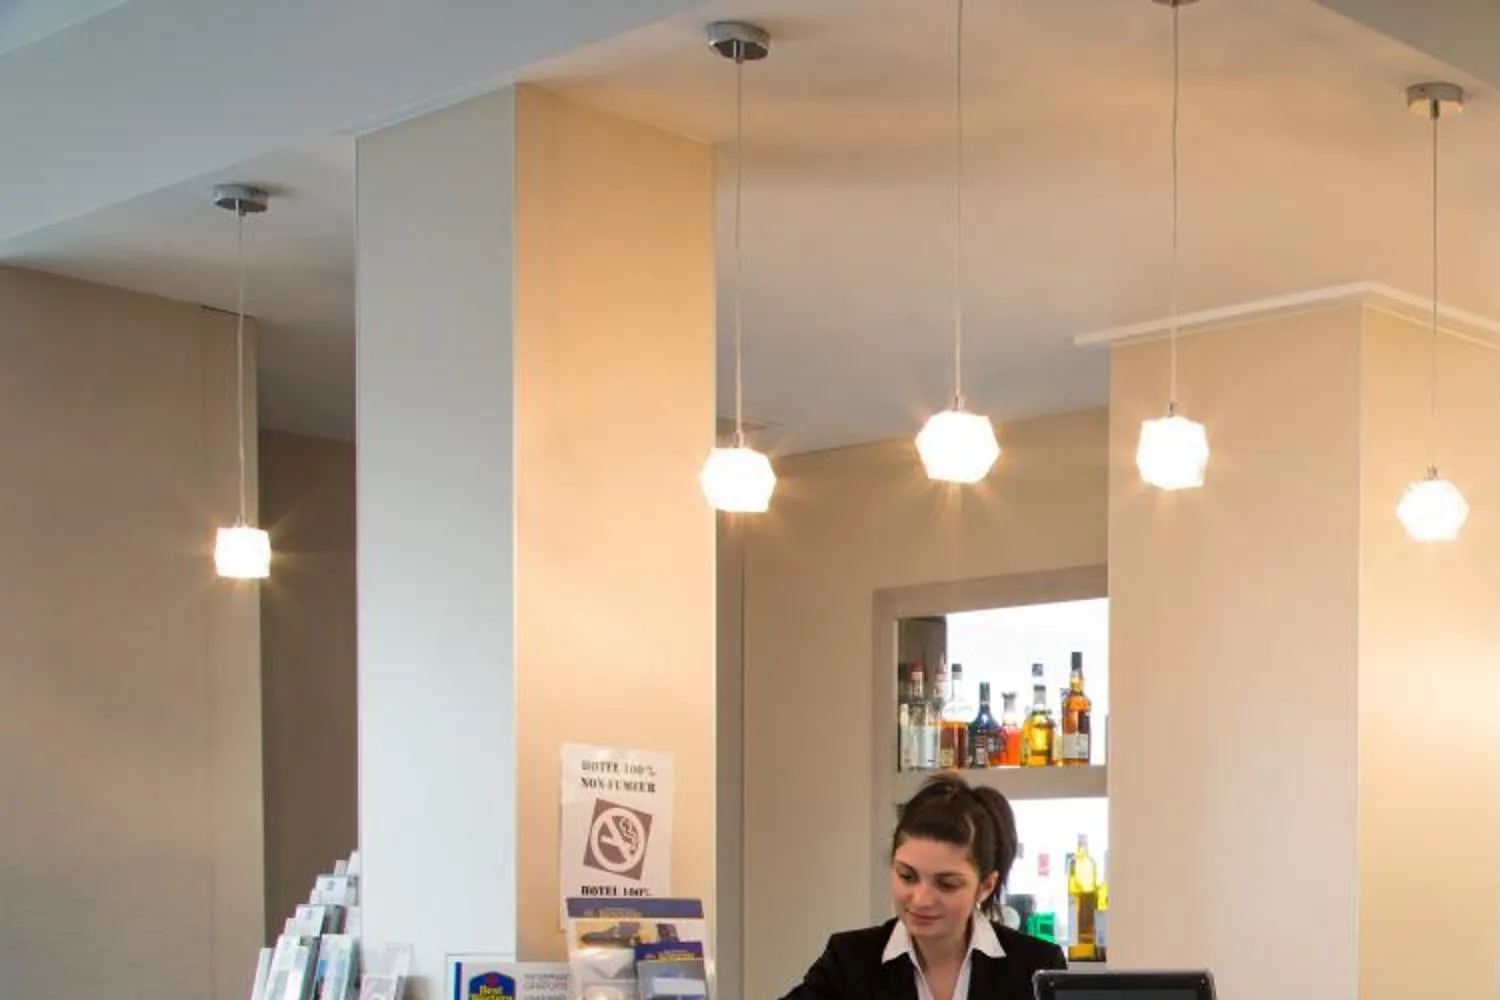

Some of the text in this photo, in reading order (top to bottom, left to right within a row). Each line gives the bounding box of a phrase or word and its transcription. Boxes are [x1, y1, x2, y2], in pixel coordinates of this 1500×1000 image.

[581, 759, 619, 773] HOTEL
[581, 885, 618, 896] HOTEL
[479, 985, 503, 996] Best
